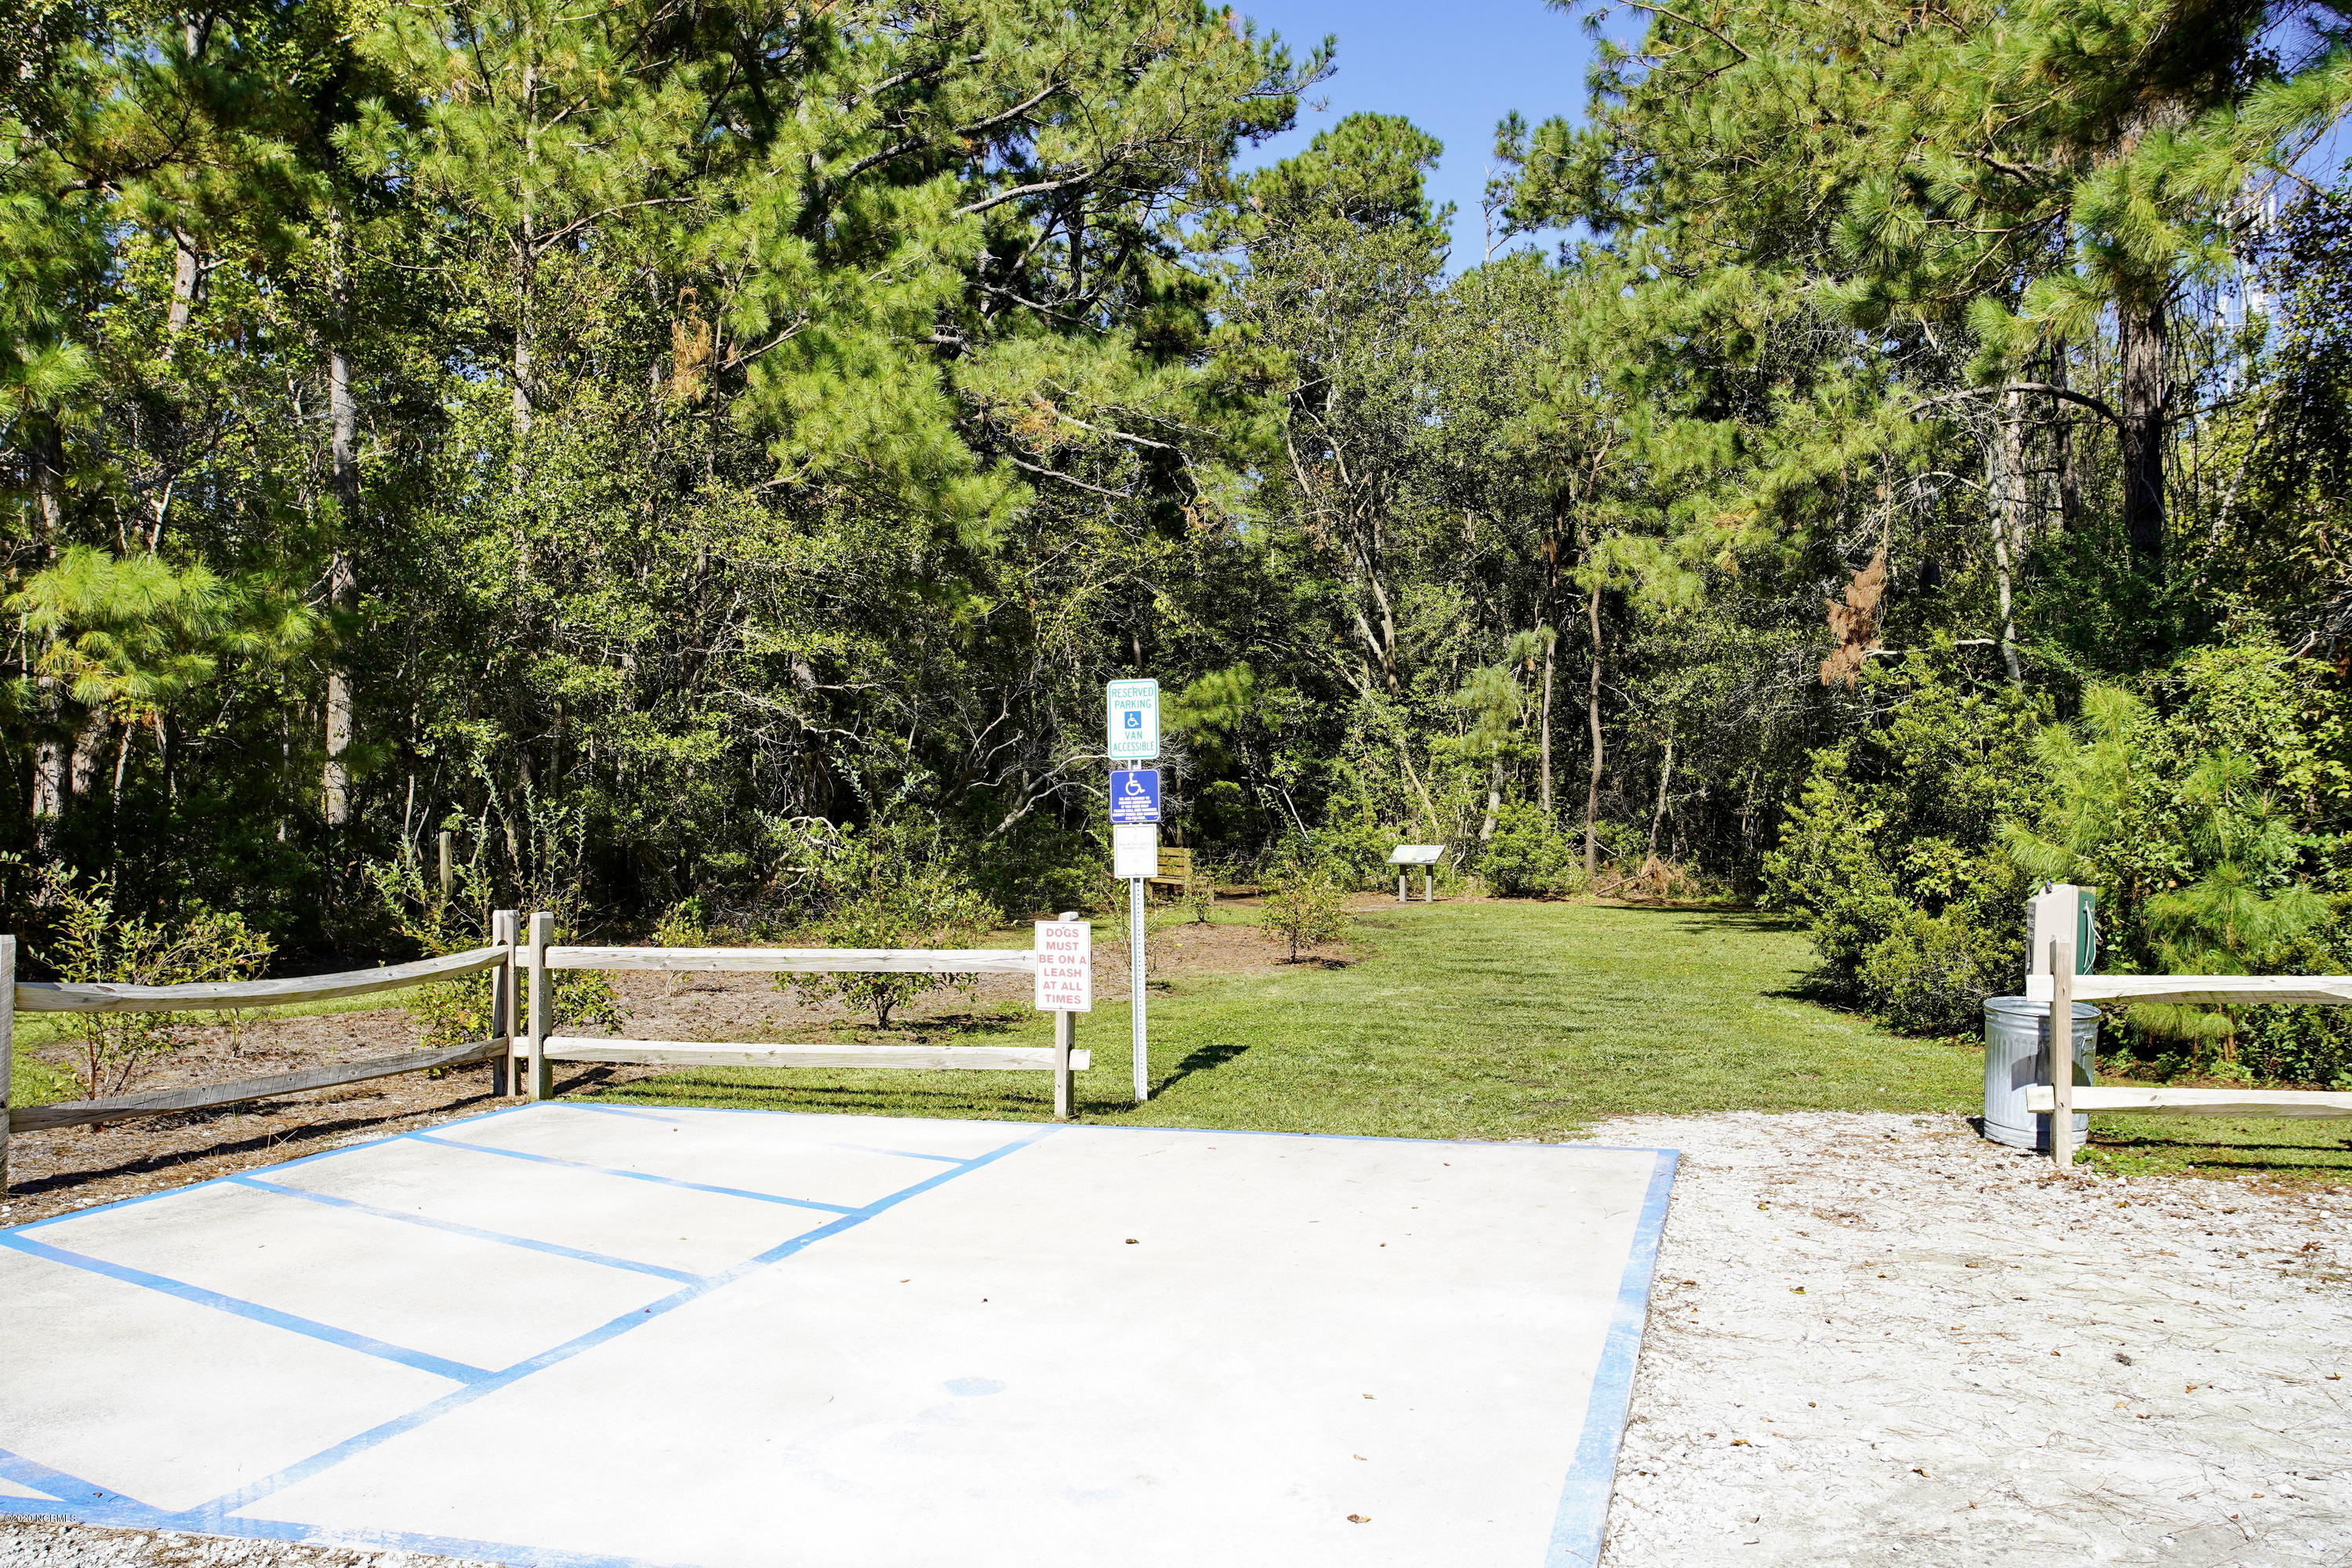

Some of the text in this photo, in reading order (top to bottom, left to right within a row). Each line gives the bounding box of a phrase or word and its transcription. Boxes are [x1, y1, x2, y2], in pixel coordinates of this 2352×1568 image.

[1112, 687, 1154, 698] RESERVED
[1114, 699, 1152, 710] PARKING
[1124, 731, 1143, 740] VAN
[1113, 741, 1155, 752] ACCESSIBLE
[1046, 928, 1079, 938] DOGS
[1046, 942, 1079, 951] MUST
[1039, 954, 1087, 964] BE ON A
[1044, 968, 1082, 978] LEASH
[1043, 981, 1083, 991] AT ALL
[1045, 994, 1081, 1004] TIMES
